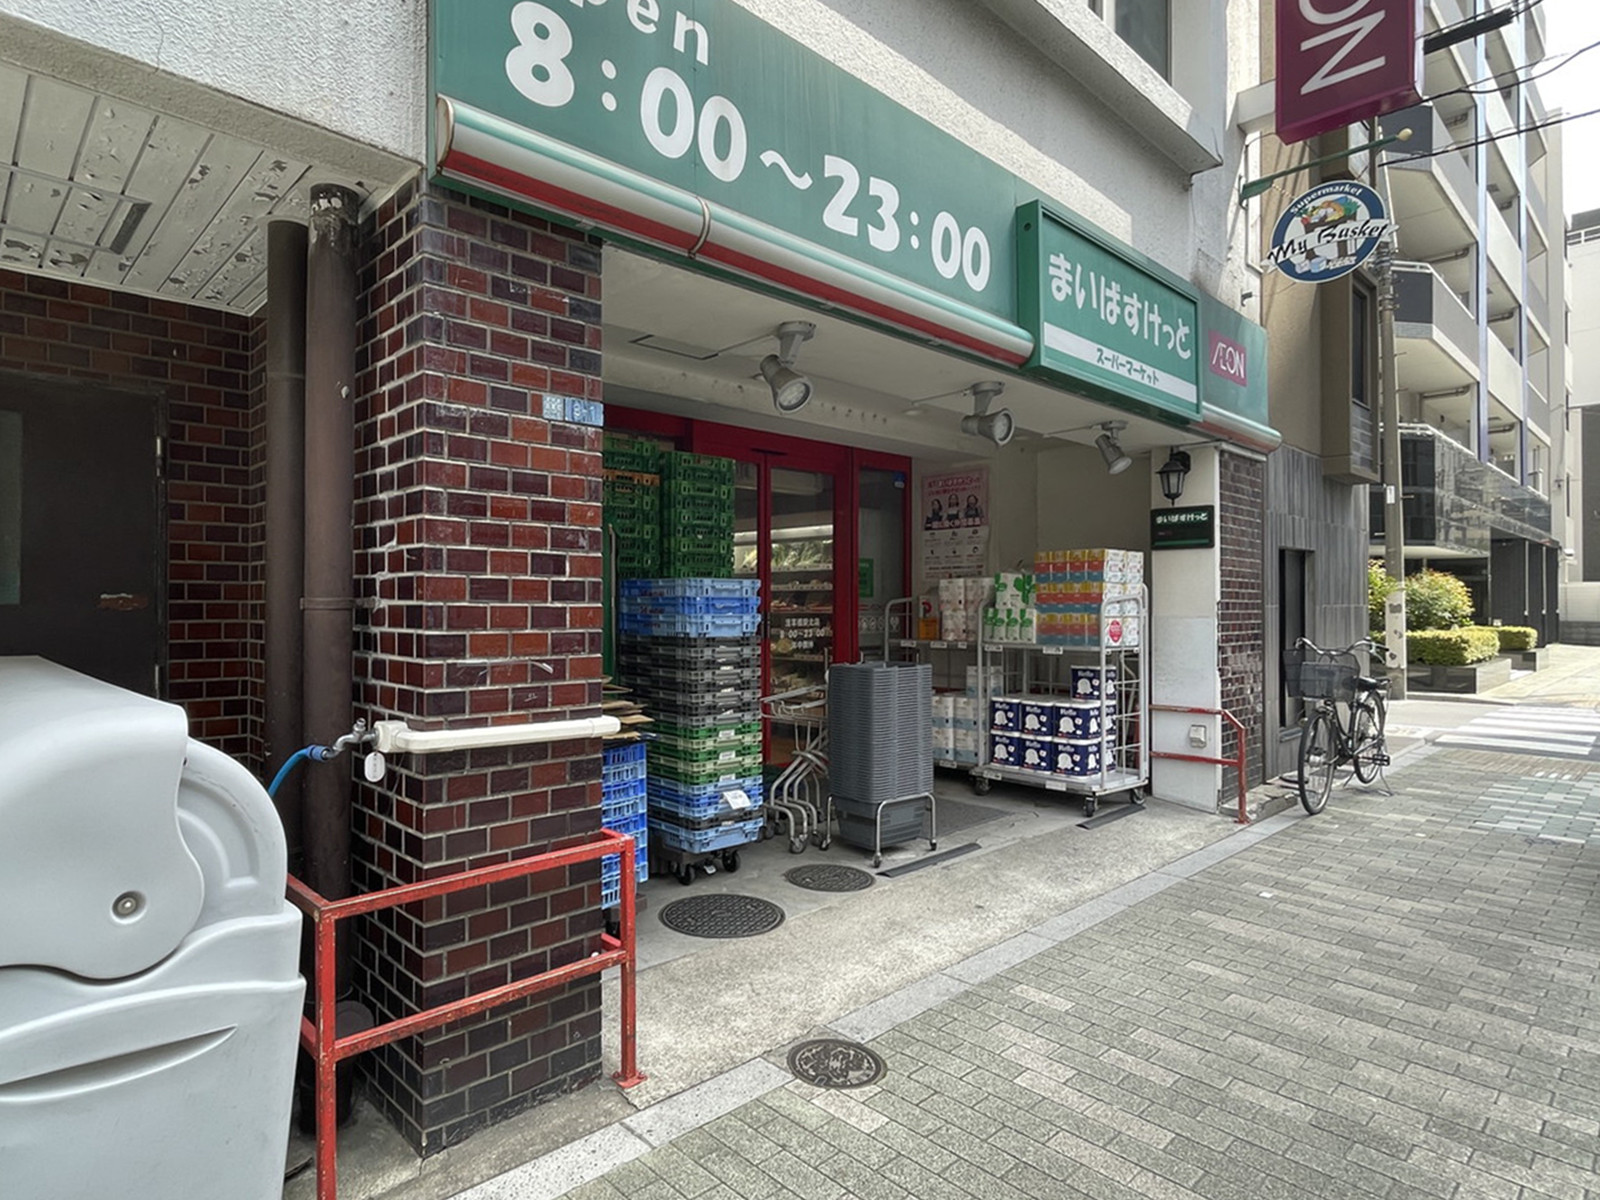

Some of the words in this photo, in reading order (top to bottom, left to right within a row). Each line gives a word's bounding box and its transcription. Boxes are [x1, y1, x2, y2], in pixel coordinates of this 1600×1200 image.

[569, 0, 709, 66] en
[1267, 238, 1308, 264] My
[1318, 219, 1388, 243] Basket
[1049, 253, 1192, 360] まいばすけっと
[1096, 347, 1160, 386] スーパーマーケット
